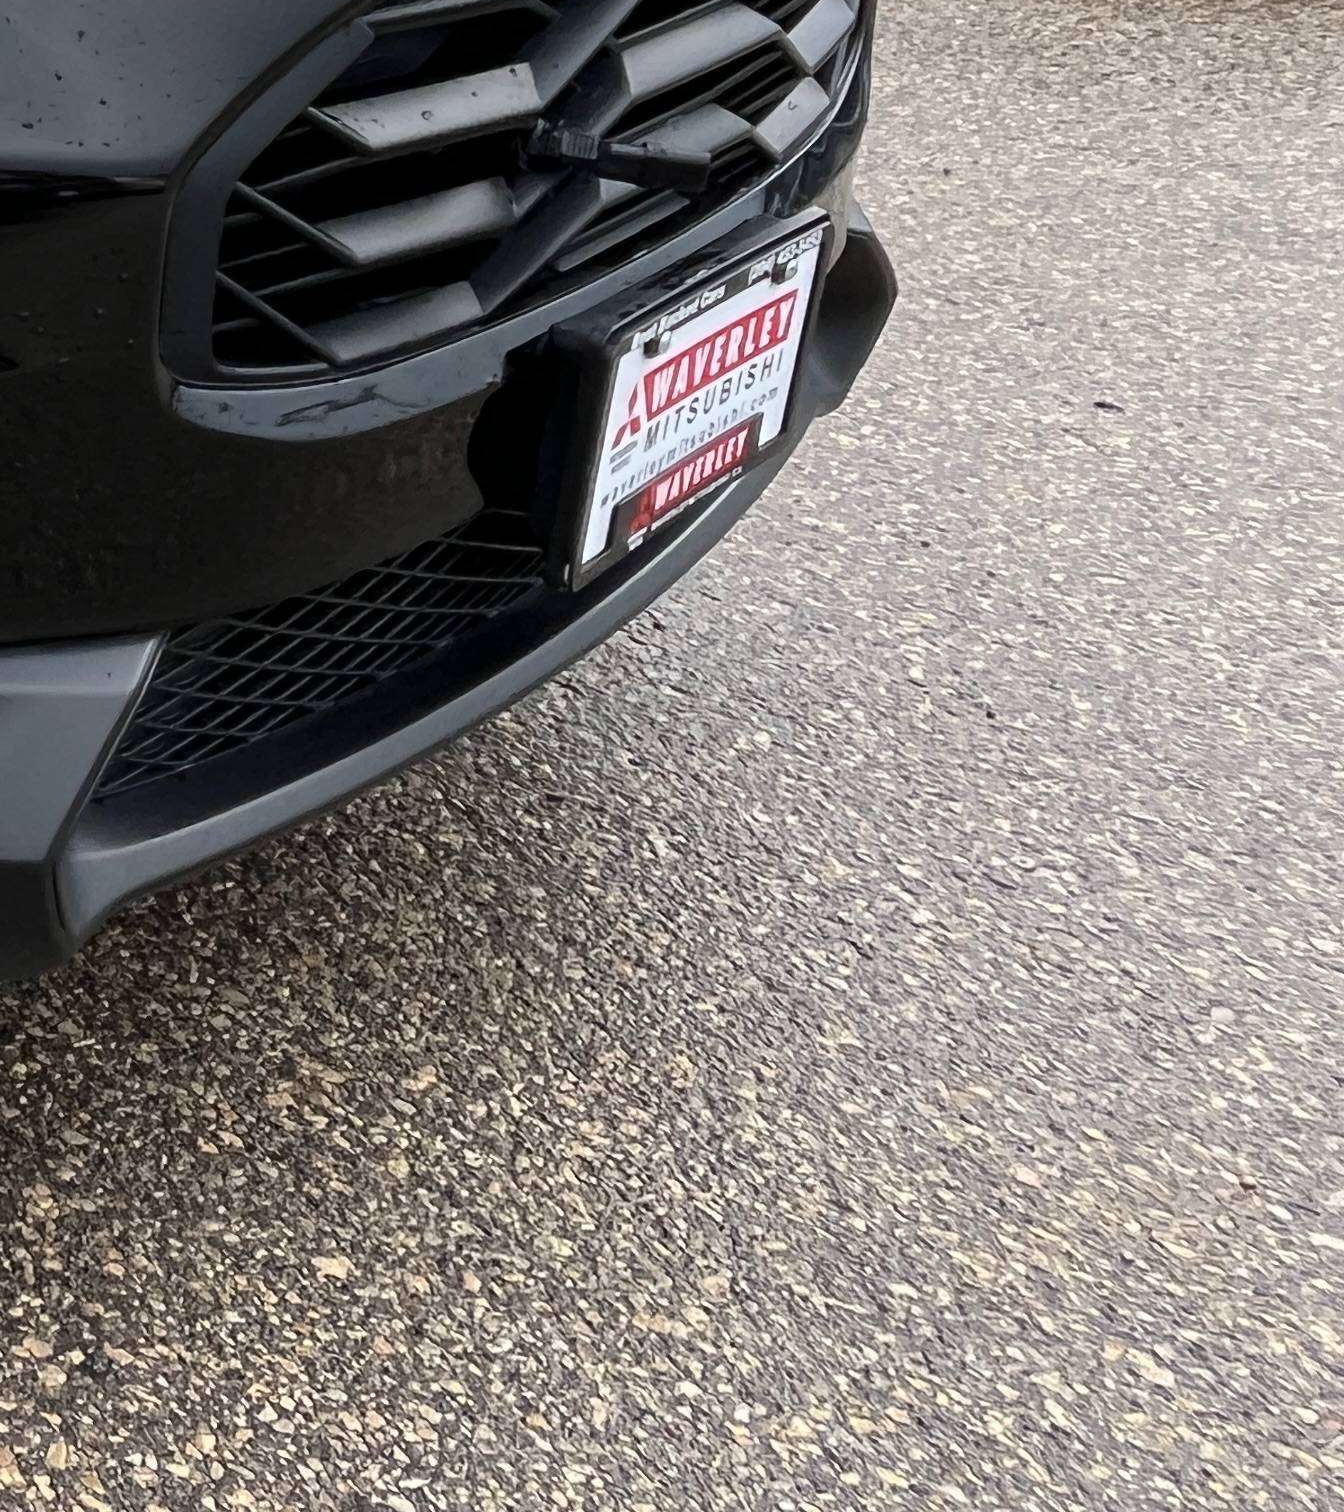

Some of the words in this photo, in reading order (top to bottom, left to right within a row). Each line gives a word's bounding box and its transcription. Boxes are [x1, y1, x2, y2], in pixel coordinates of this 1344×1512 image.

[644, 348, 784, 452] MITSUBISHI
[651, 294, 796, 413] WAVERLEY
[654, 427, 750, 510] WAVERLEY
